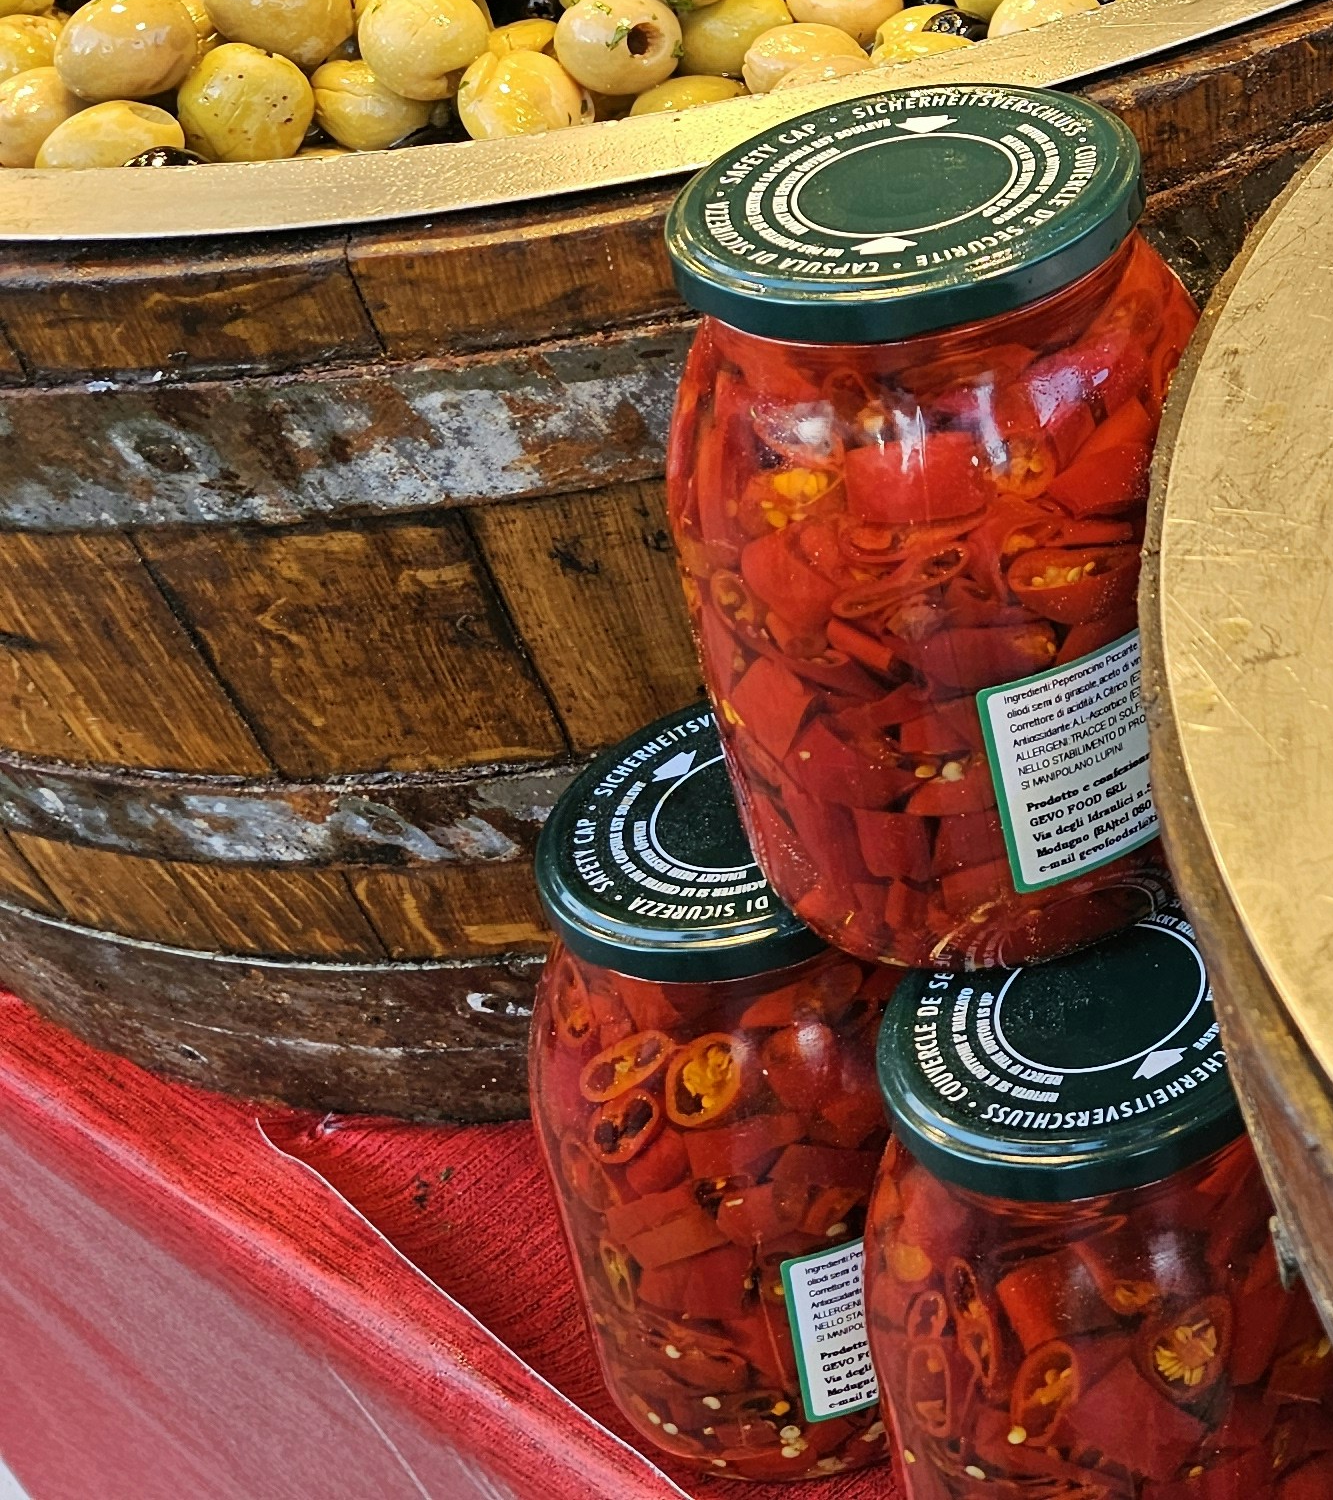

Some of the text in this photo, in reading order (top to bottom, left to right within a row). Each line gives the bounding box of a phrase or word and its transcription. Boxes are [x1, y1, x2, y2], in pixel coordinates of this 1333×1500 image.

[852, 93, 1086, 137] SICHERHEITSVERSCHLUSS
[719, 123, 816, 185] SAFETY CAP
[915, 145, 1097, 267] COUVERCLE DE SECURITE
[705, 201, 880, 275] CAPSULA DI SICUREZZA
[1105, 642, 1138, 666] Piccante
[1054, 693, 1063, 704] di
[1122, 661, 1130, 672] di
[1010, 715, 1055, 734] Correttore
[1056, 706, 1065, 718] di
[1071, 720, 1106, 744] TRACCE
[1108, 713, 1118, 727] DI
[1119, 703, 1143, 720] SOLF
[1018, 714, 1146, 776] NELLO STABILIMENTO DI PRO
[1021, 780, 1031, 790] SI
[1033, 756, 1094, 787] MANIPOLANO
[1026, 789, 1079, 812] Prodotto
[1092, 753, 1150, 787] confezion
[1029, 781, 1127, 827] GEVO FOOD SRL
[1033, 831, 1052, 842] Via
[1055, 817, 1084, 835] degli
[1088, 793, 1134, 823] Idraulici
[1036, 834, 1089, 858] Modugno
[1132, 800, 1152, 817] 080
[1039, 813, 1159, 873] e-mail gevofoodsrl@ti
[573, 818, 614, 892] SAFETY CAP
[628, 895, 769, 920] DI SICUREZZA
[916, 996, 943, 1017] DE
[914, 1022, 969, 1101] COUVERCLE
[980, 1050, 1227, 1129] CHERHEITSVERSCHLUSS
[851, 1264, 859, 1272] di
[852, 1276, 860, 1284] di
[814, 1316, 844, 1332] NELLO
[816, 1334, 825, 1343] SI
[822, 1357, 854, 1373] GEVO
[824, 1362, 872, 1385] Via degli
[828, 1392, 862, 1409] e-mail
